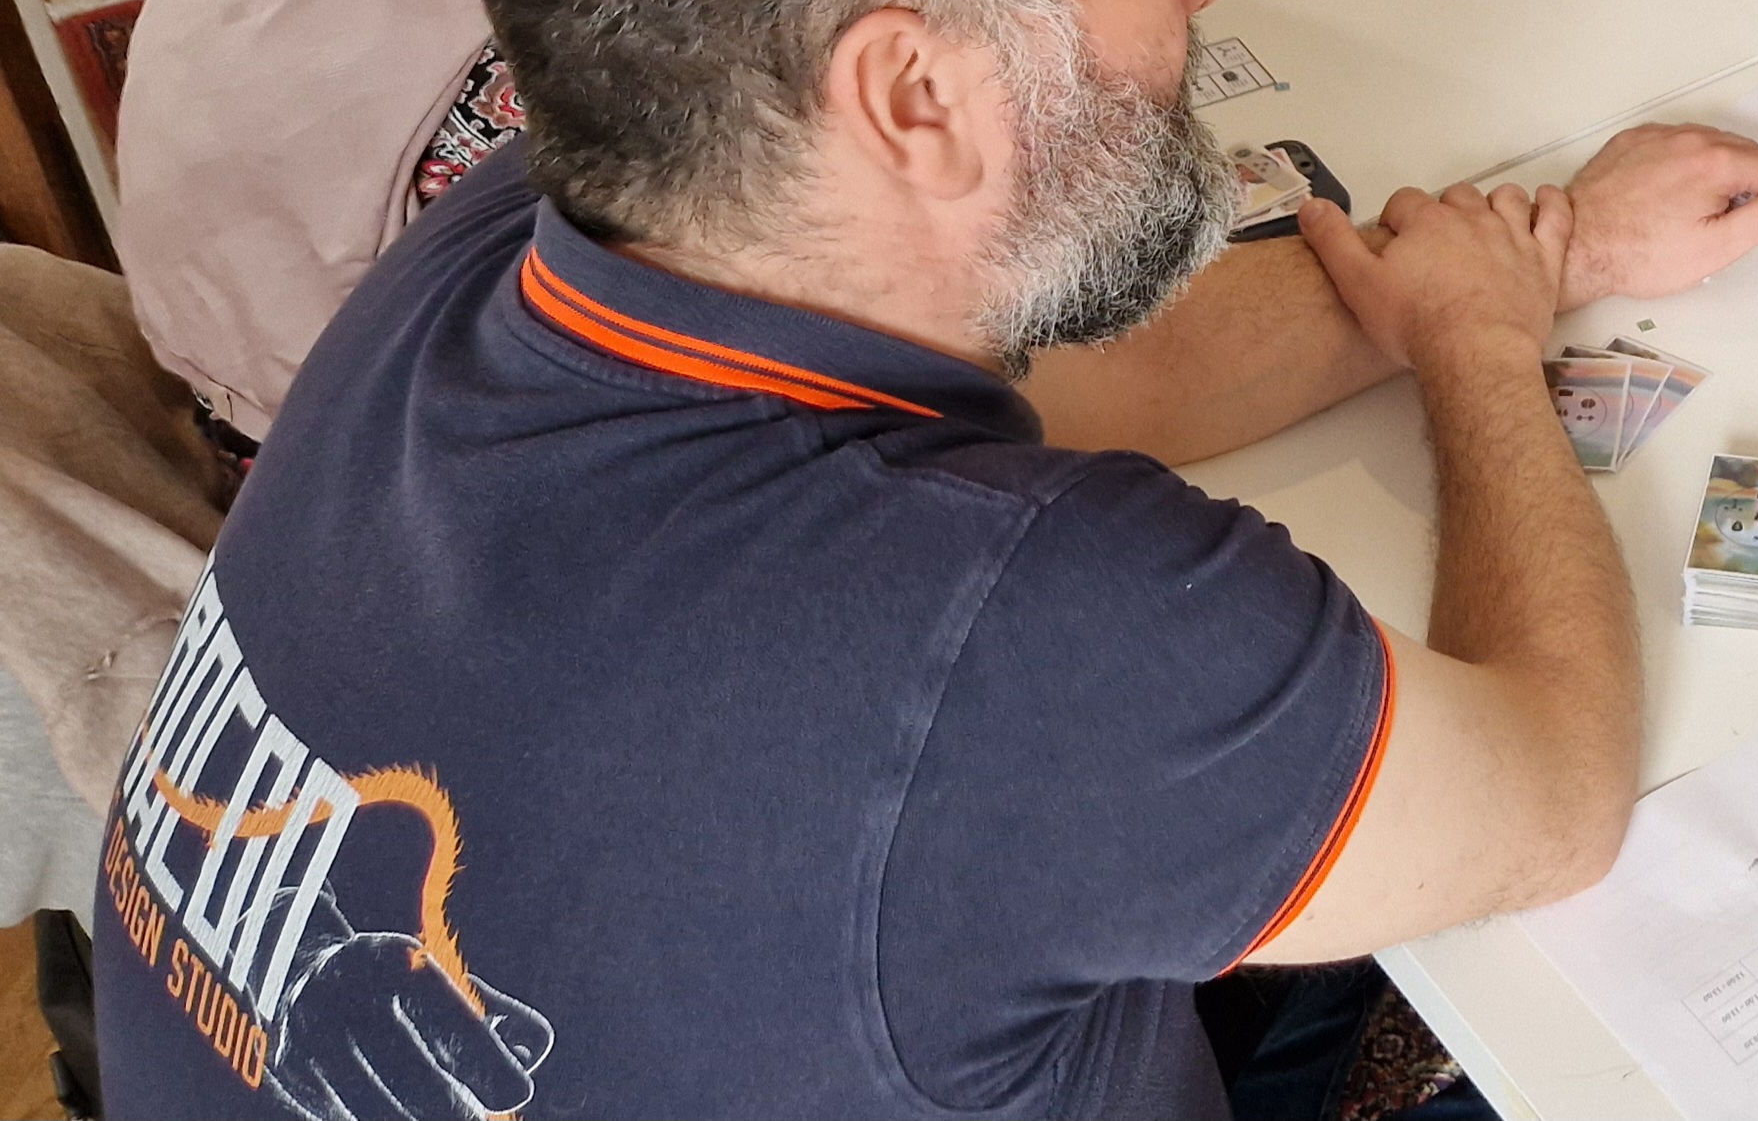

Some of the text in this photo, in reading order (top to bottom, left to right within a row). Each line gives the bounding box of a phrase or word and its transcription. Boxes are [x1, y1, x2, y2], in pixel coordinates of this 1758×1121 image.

[104, 816, 268, 1091] DESIGN STUDIO
[122, 546, 360, 1022] RACON
